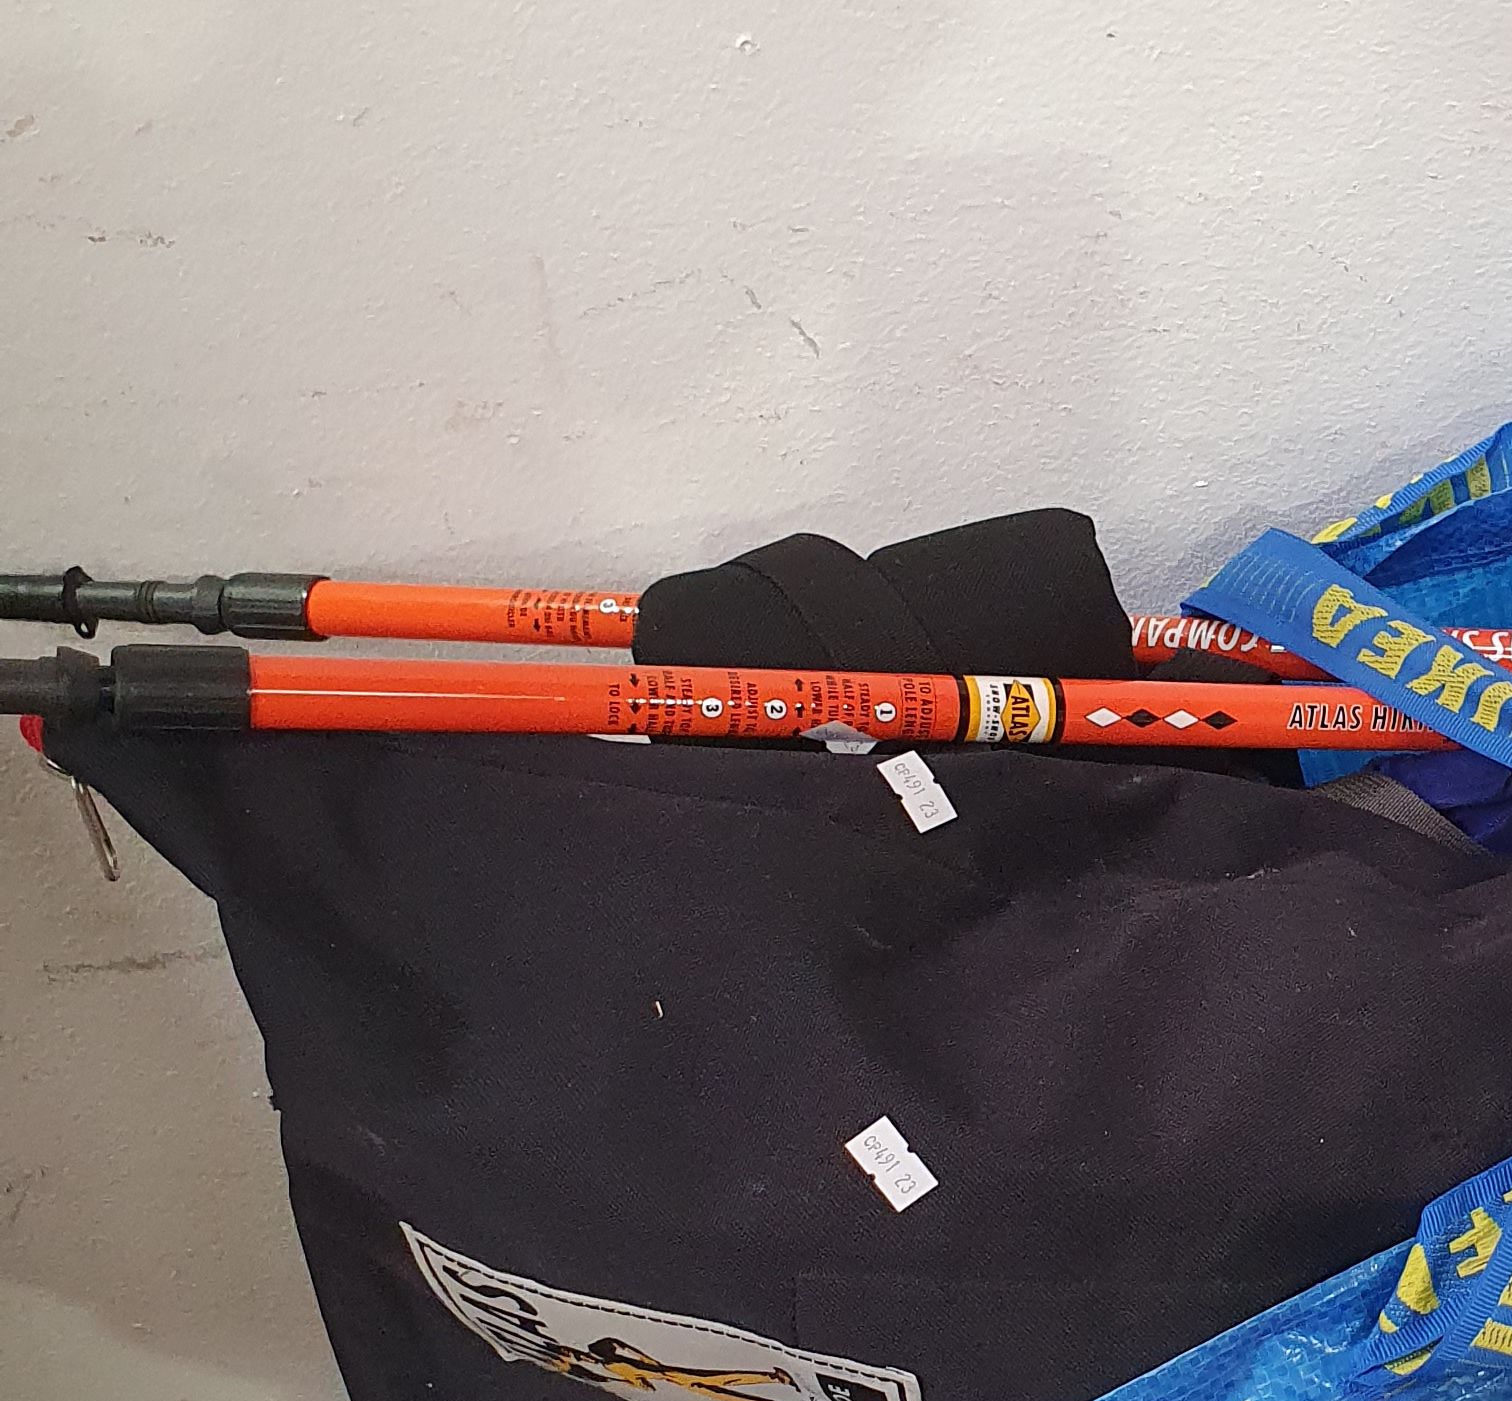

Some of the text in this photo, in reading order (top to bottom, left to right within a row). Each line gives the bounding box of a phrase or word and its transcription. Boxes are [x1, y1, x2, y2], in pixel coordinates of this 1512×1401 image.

[857, 682, 871, 718] STEADY
[918, 681, 931, 695] TO
[607, 683, 621, 726] TO LOCK
[706, 704, 719, 713] 3
[746, 682, 759, 721] ADJUST
[770, 704, 783, 715] 2
[1008, 695, 1031, 737] ATLAS
[1286, 702, 1363, 732] ATLAS
[918, 800, 940, 820] 23
[894, 1173, 917, 1194] 23
